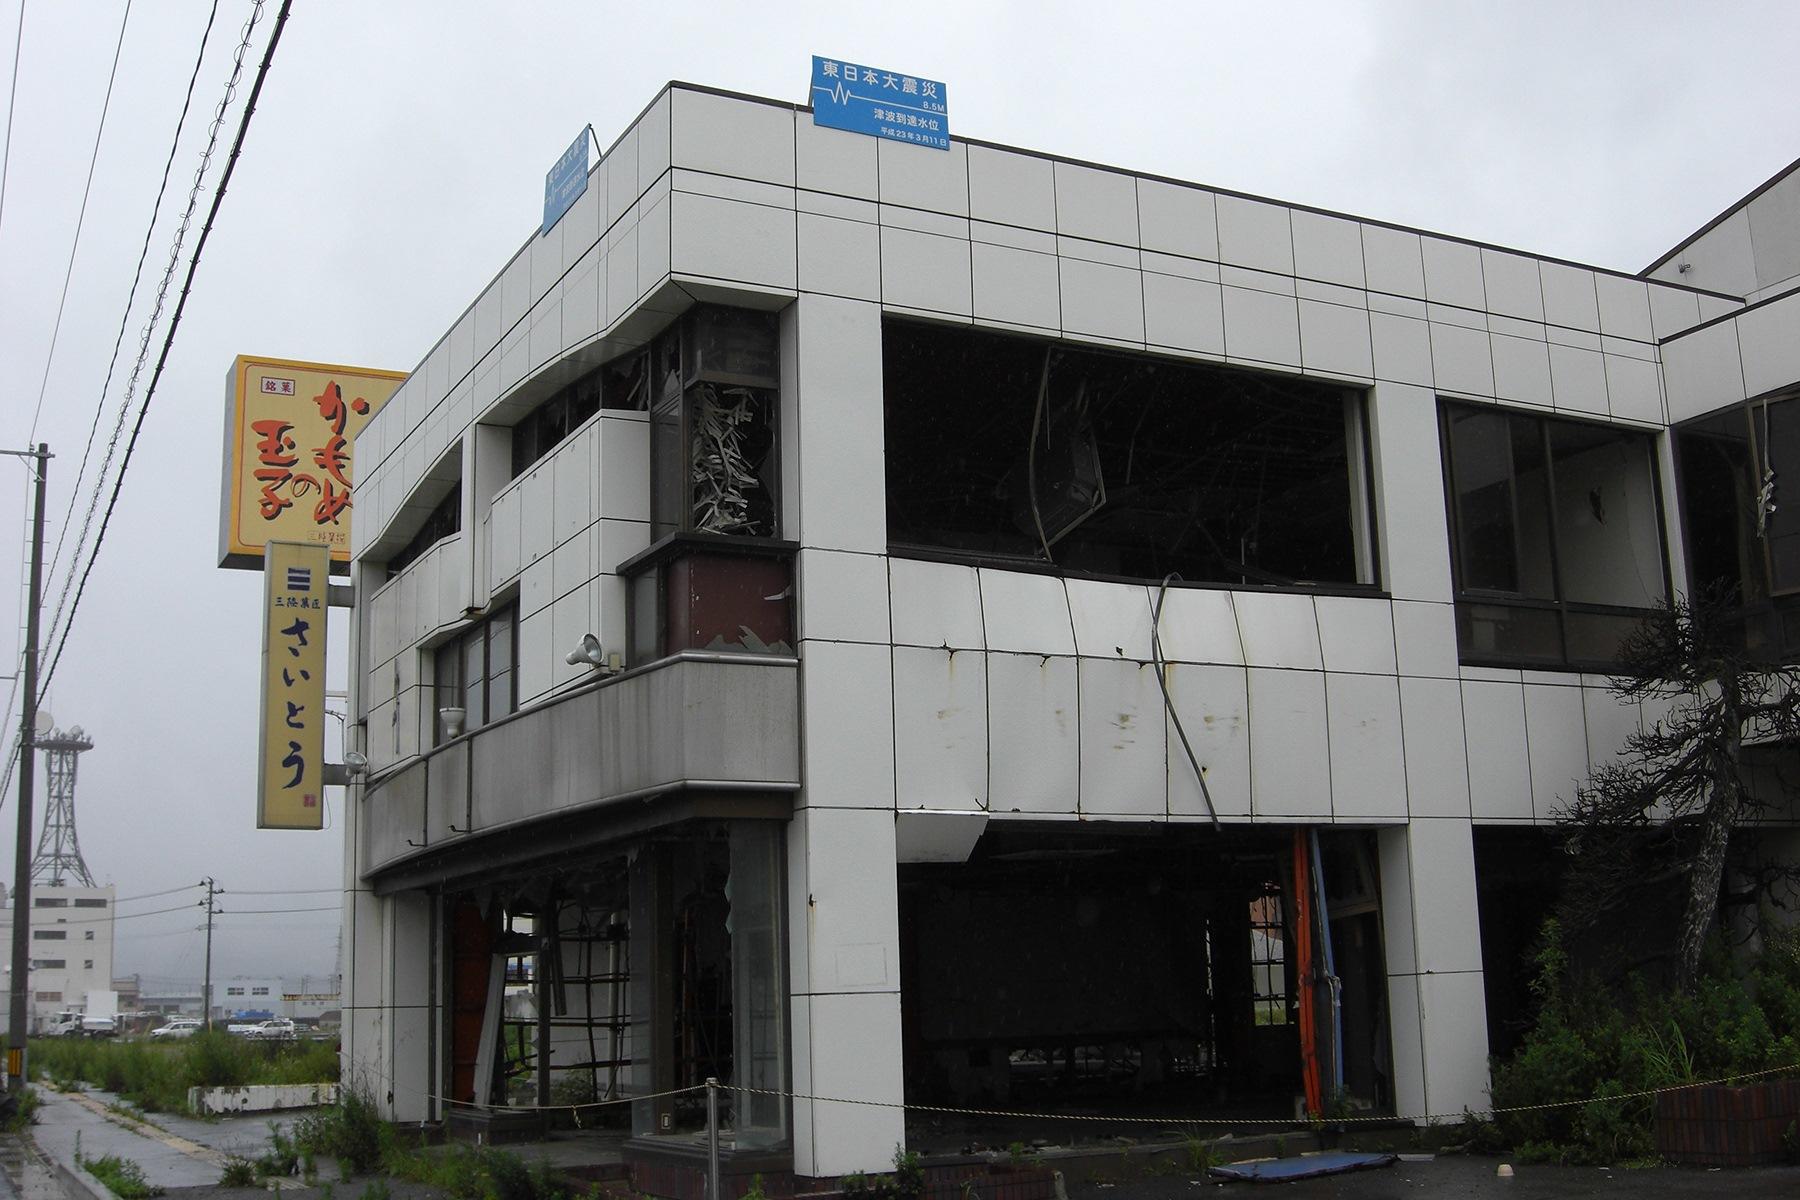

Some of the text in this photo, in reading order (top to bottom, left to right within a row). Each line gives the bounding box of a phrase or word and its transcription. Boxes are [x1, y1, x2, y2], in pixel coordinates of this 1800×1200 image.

[822, 60, 938, 99] 東日本大震災
[874, 108, 940, 131] 津波到達水位
[280, 617, 311, 789] さいとう
